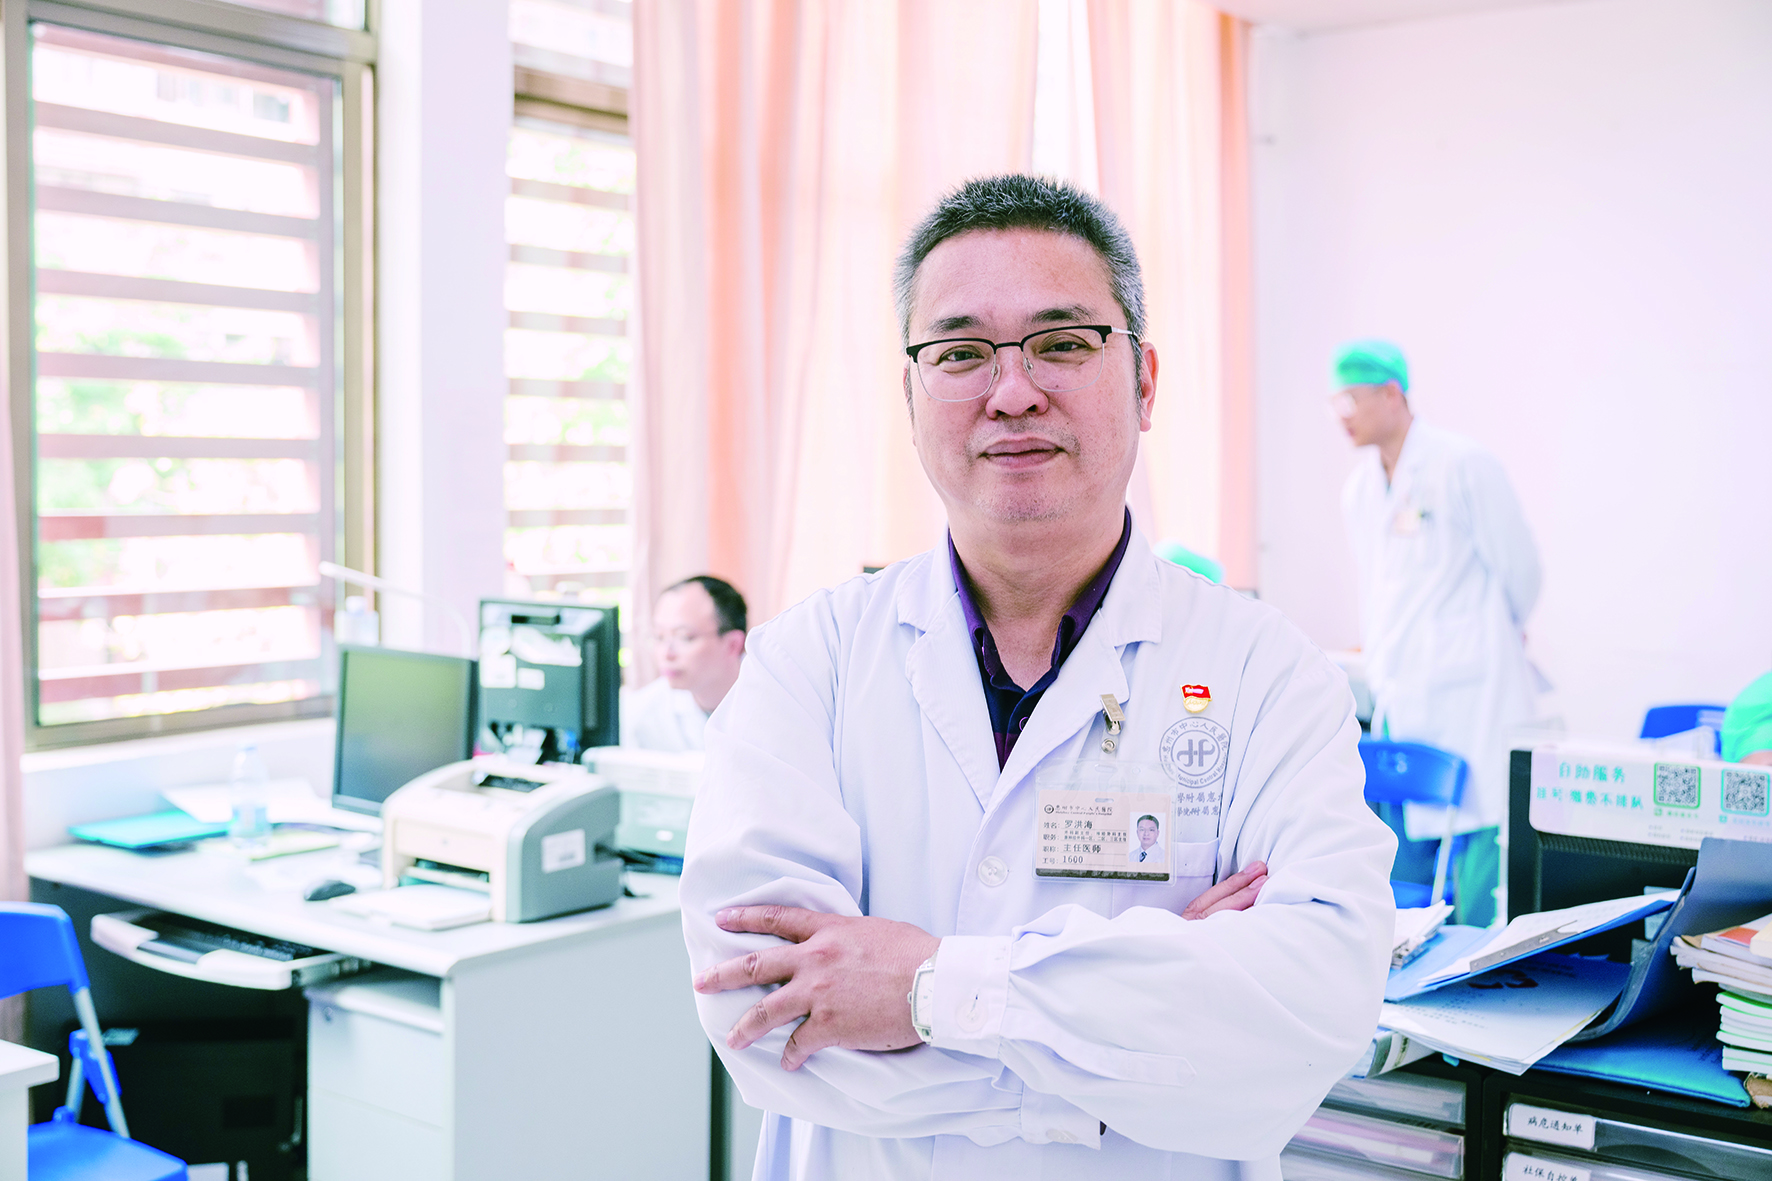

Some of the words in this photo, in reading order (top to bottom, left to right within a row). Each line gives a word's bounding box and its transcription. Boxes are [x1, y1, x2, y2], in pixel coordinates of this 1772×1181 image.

[1559, 761, 1625, 783] 自助服务
[1064, 819, 1093, 829] 罗洪海
[1063, 843, 1102, 854] 主任医师
[1063, 855, 1084, 864] 1600
[1528, 1116, 1583, 1134] 病危通知单
